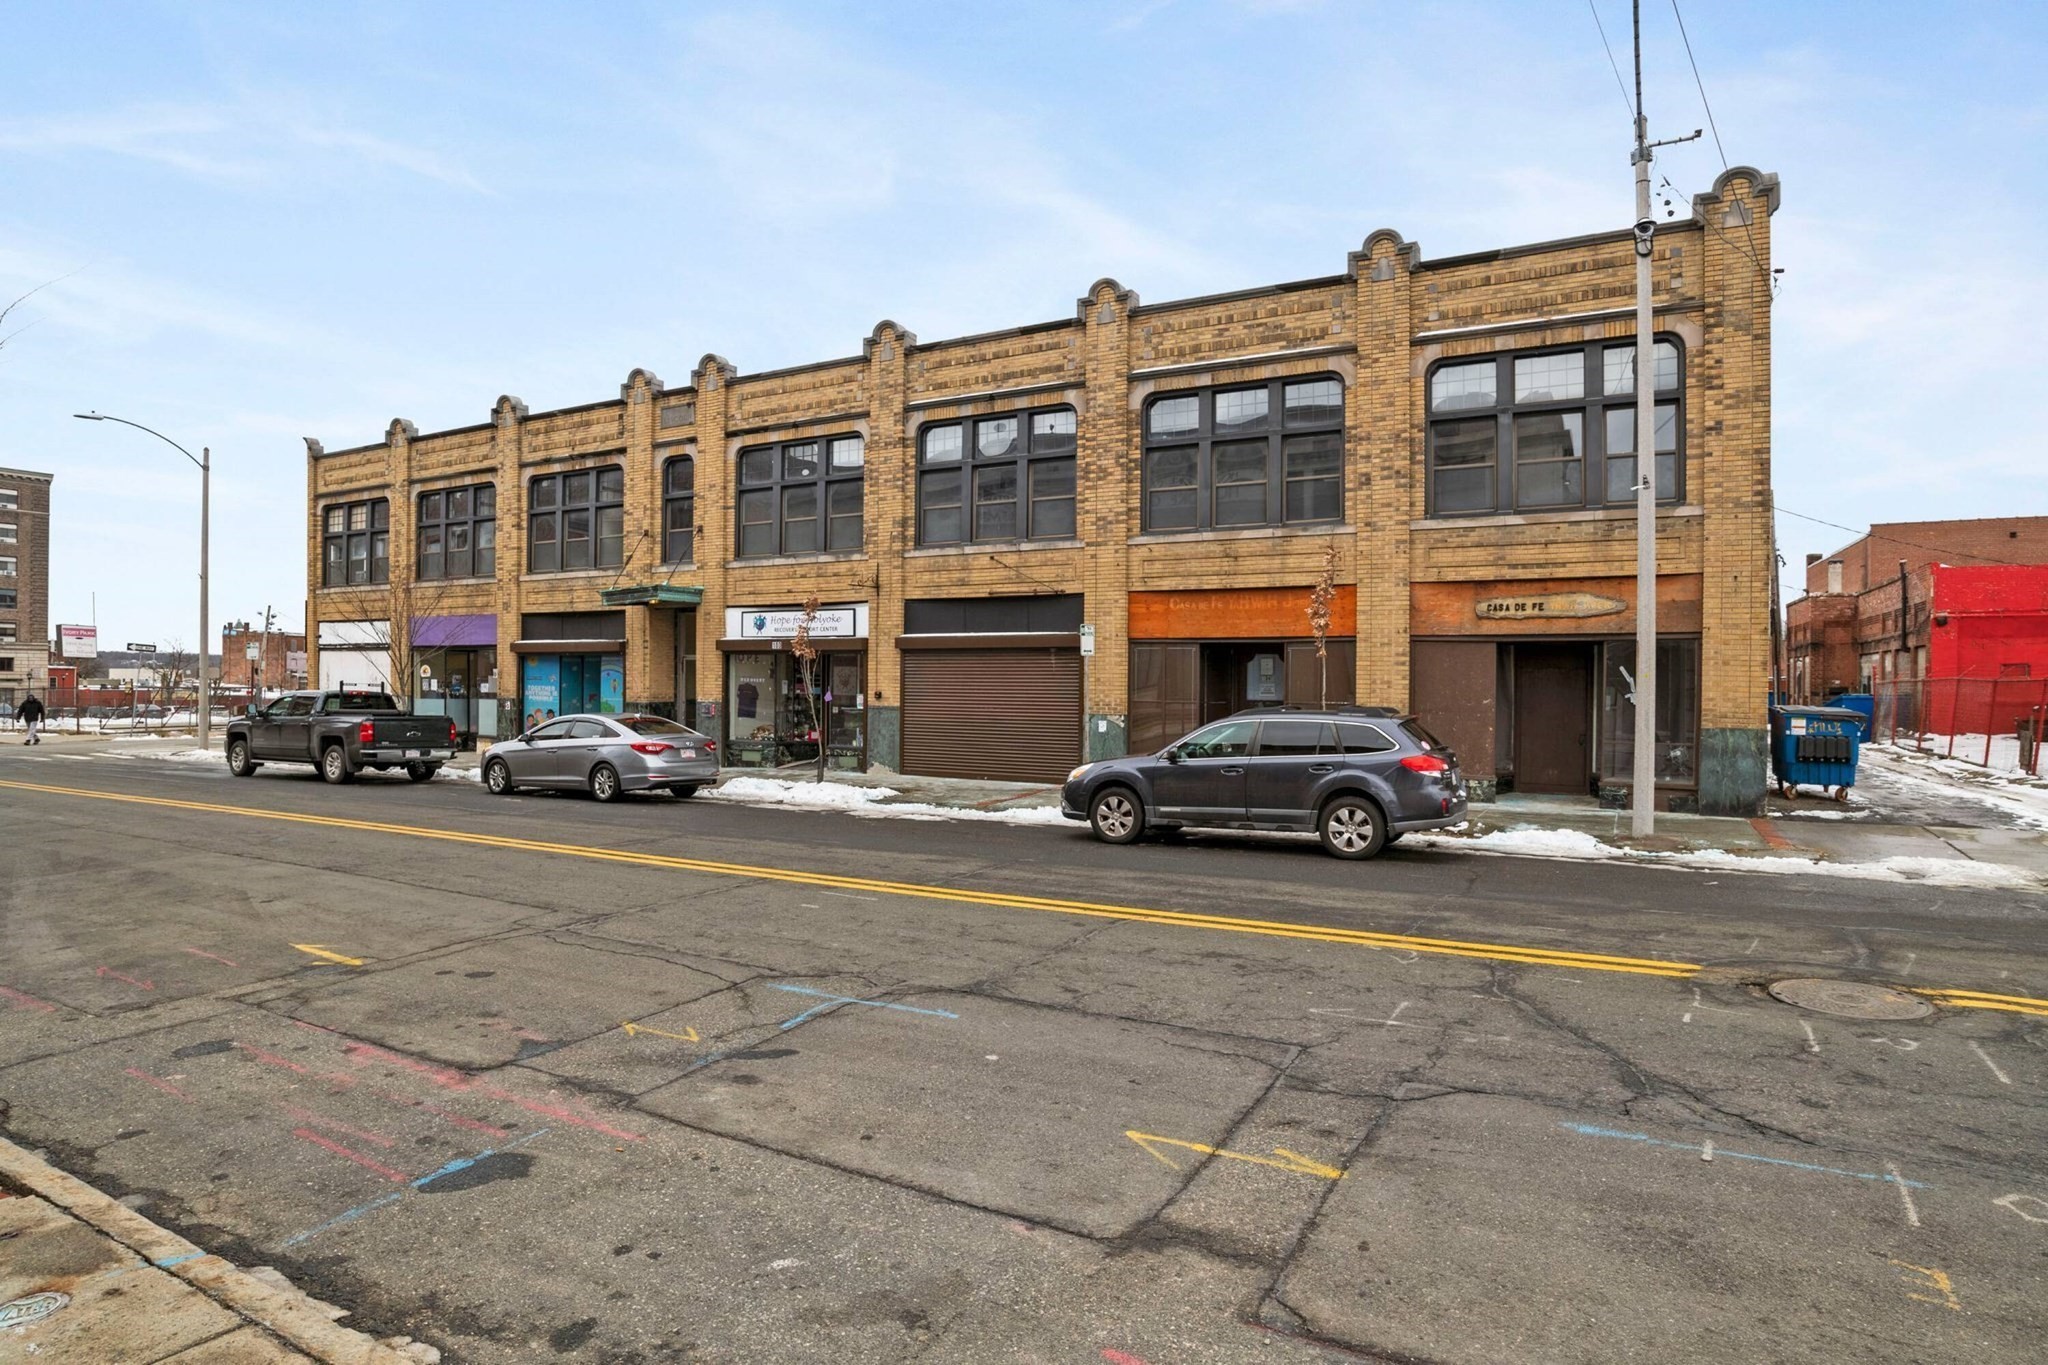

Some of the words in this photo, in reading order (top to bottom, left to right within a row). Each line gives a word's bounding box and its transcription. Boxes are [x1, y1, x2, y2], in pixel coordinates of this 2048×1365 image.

[1487, 603, 1510, 612] CASA
[1514, 603, 1527, 612] DE
[1532, 602, 1545, 612] FE
[770, 615, 792, 627] Hope
[810, 613, 842, 626] olyoke
